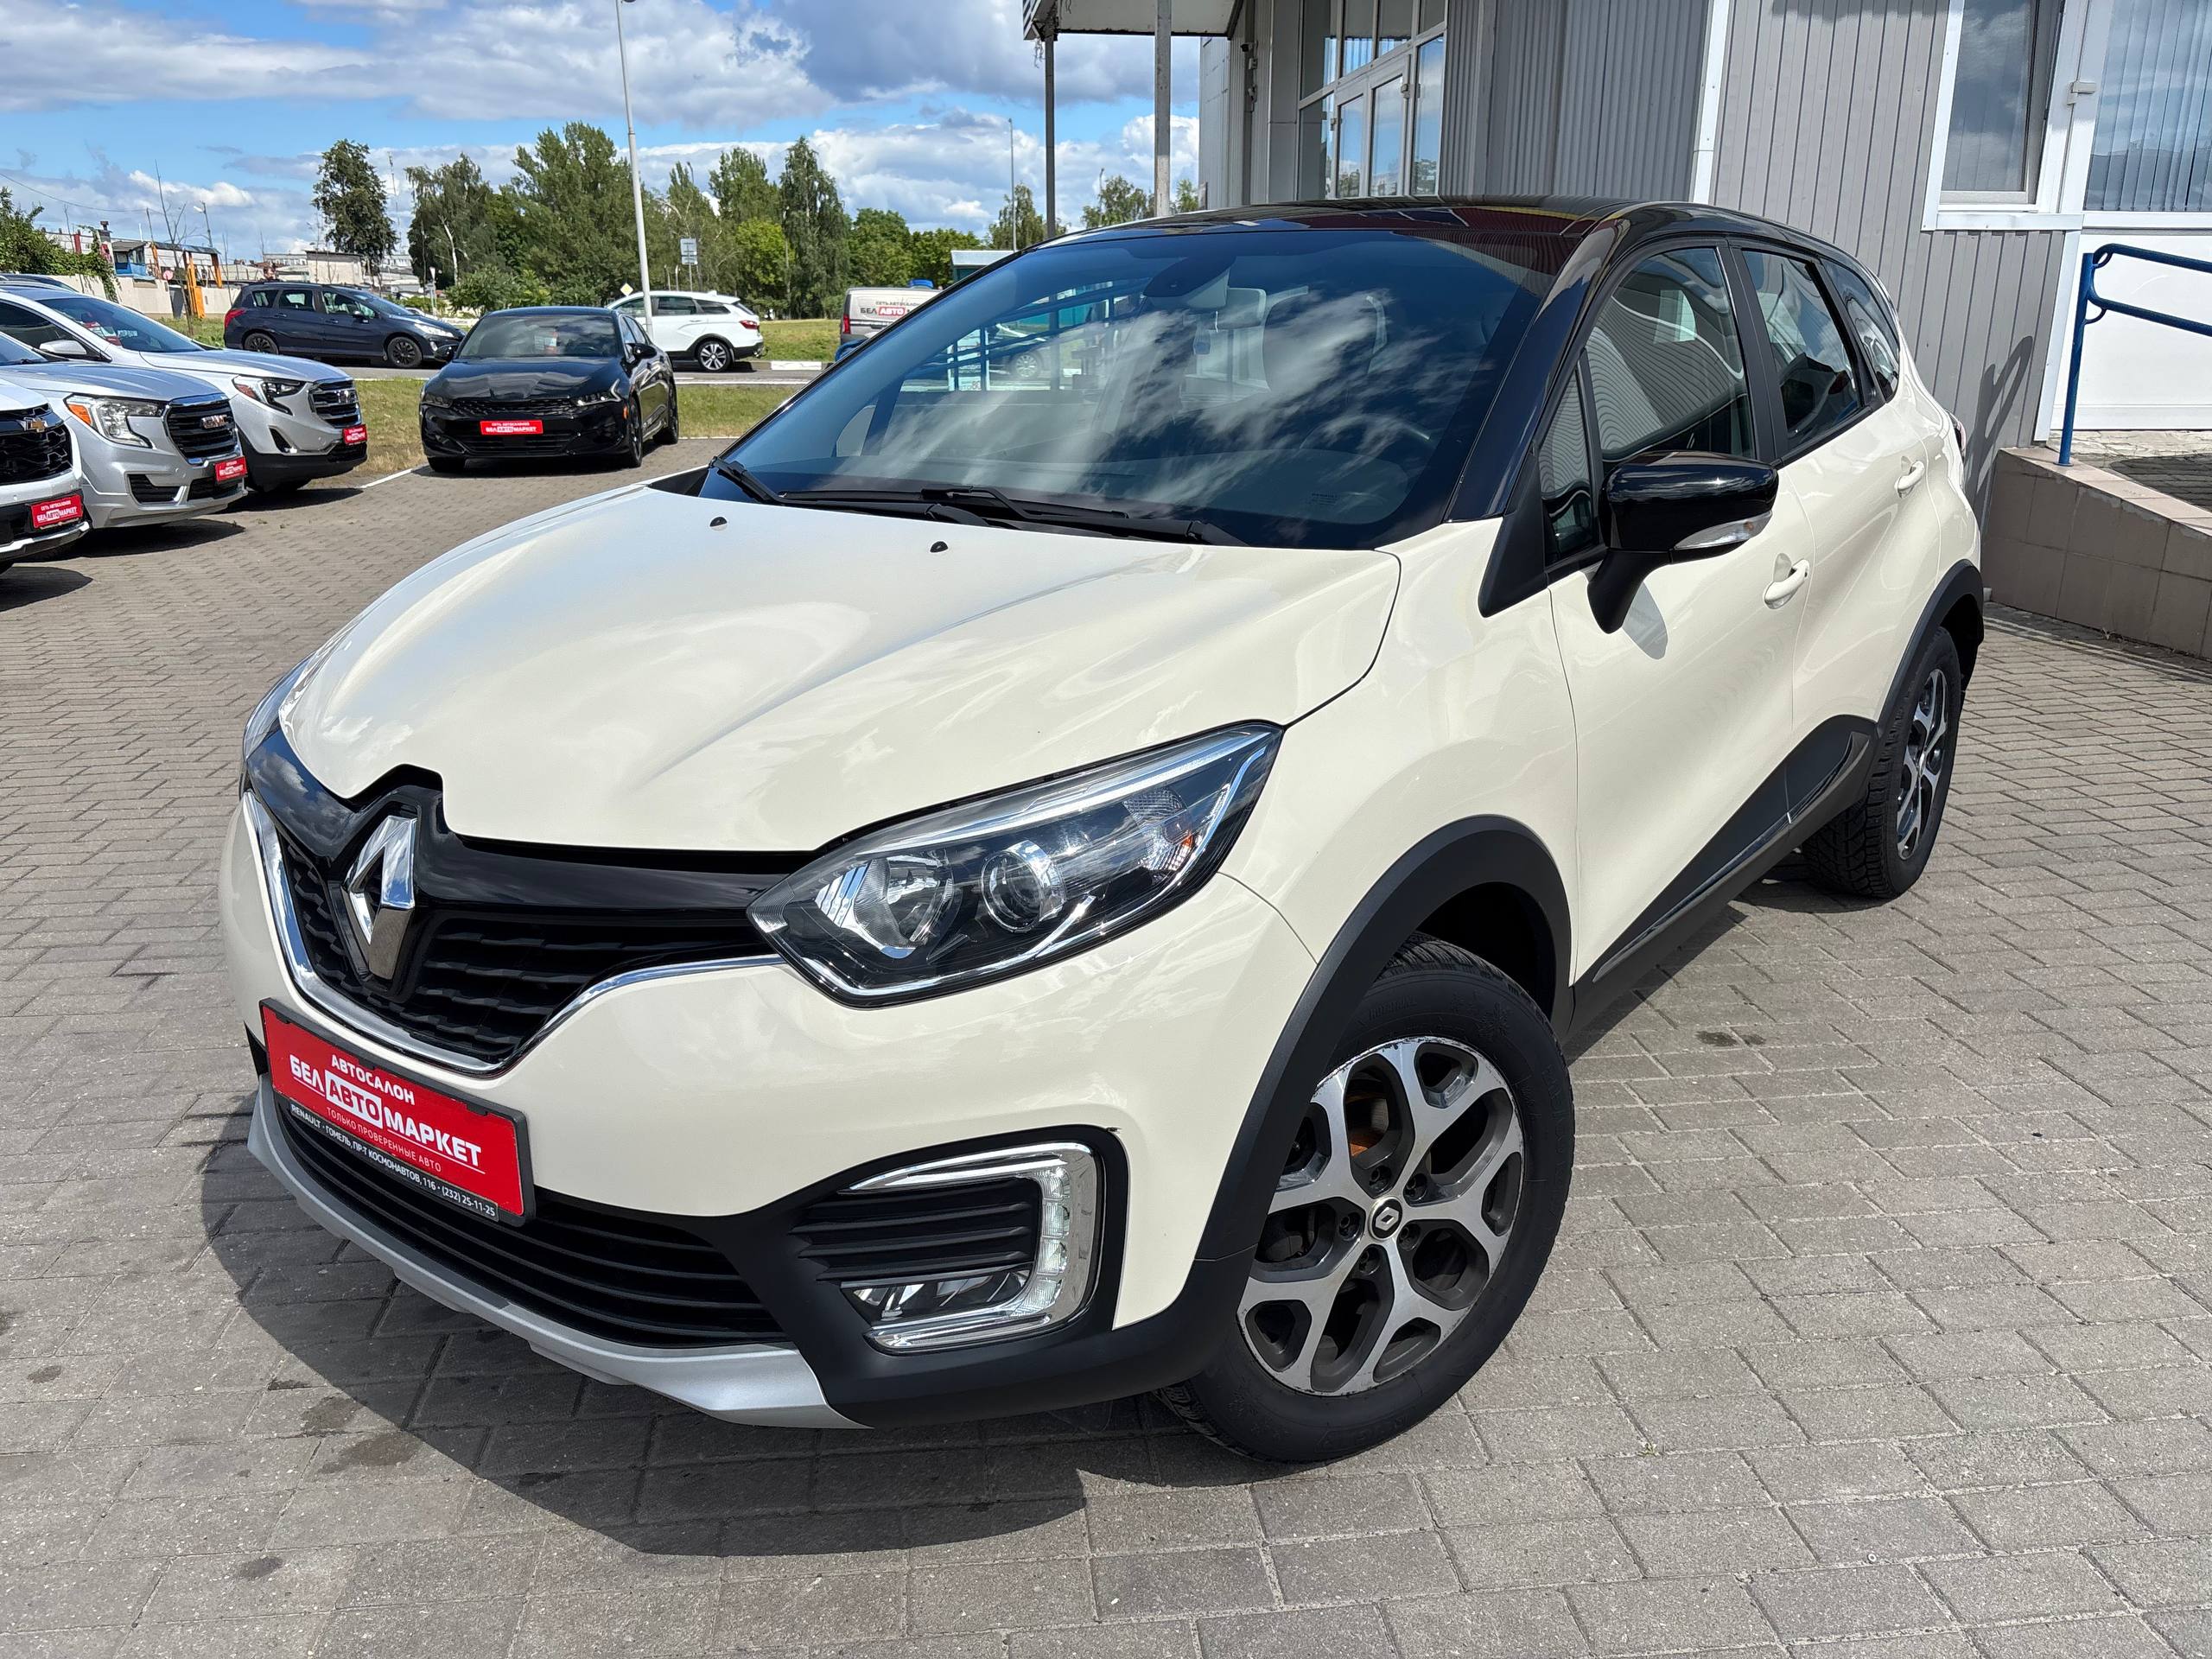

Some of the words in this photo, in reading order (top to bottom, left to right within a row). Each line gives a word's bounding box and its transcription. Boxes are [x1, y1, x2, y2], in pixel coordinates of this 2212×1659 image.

[331, 1054, 416, 1106] АВТОСАЛОН
[290, 1104, 321, 1128] RENAULT
[423, 1178, 436, 1191] 116
[442, 1185, 461, 1204] (232)
[462, 1195, 496, 1217] 25-11-25
[327, 1107, 356, 1130] ТОЛЬКО
[358, 1126, 416, 1161] ПРОВЕРЕННЫЕ
[418, 1154, 442, 1173] АВТО
